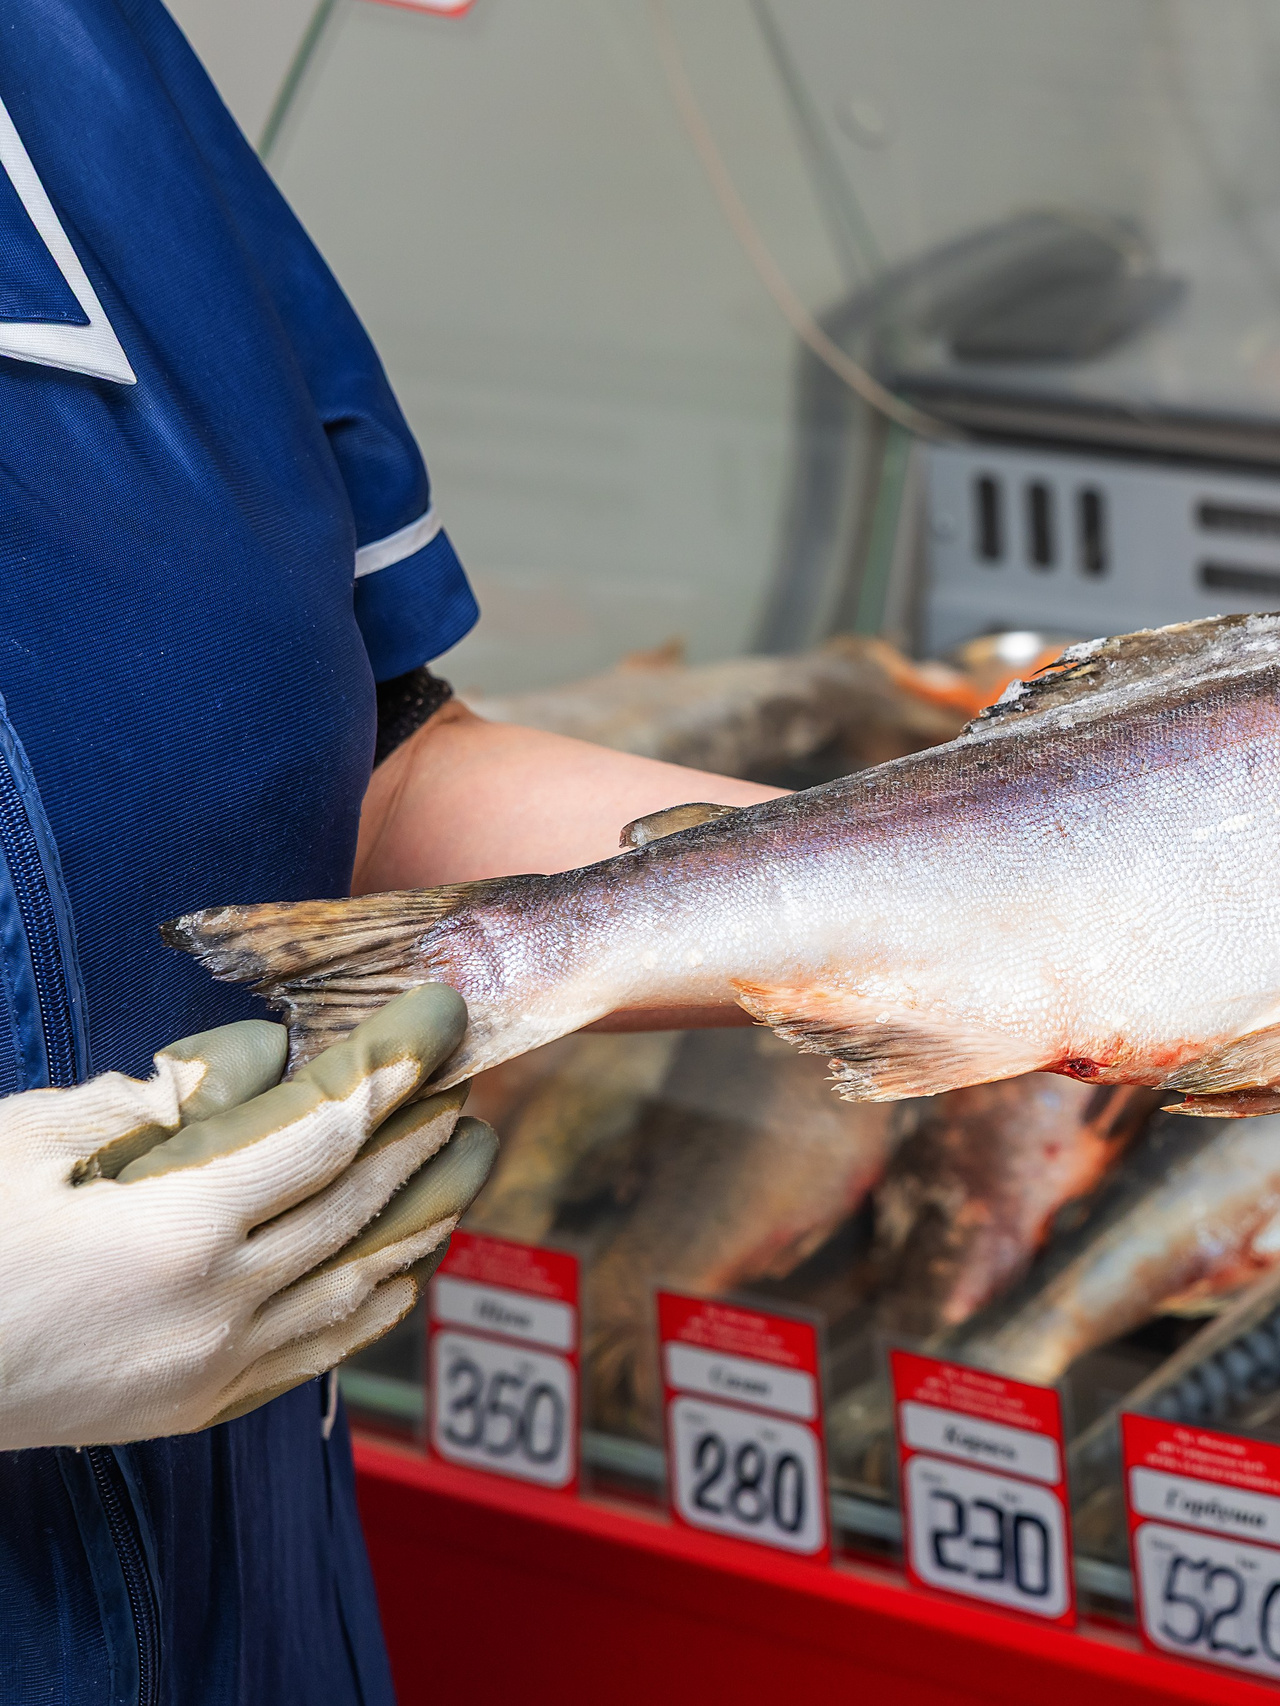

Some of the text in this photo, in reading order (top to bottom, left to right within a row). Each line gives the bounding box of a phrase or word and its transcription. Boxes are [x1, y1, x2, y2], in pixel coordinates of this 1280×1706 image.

[443, 1358, 564, 1464] 350
[692, 1432, 805, 1534] 280
[930, 1489, 1051, 1596] 230
